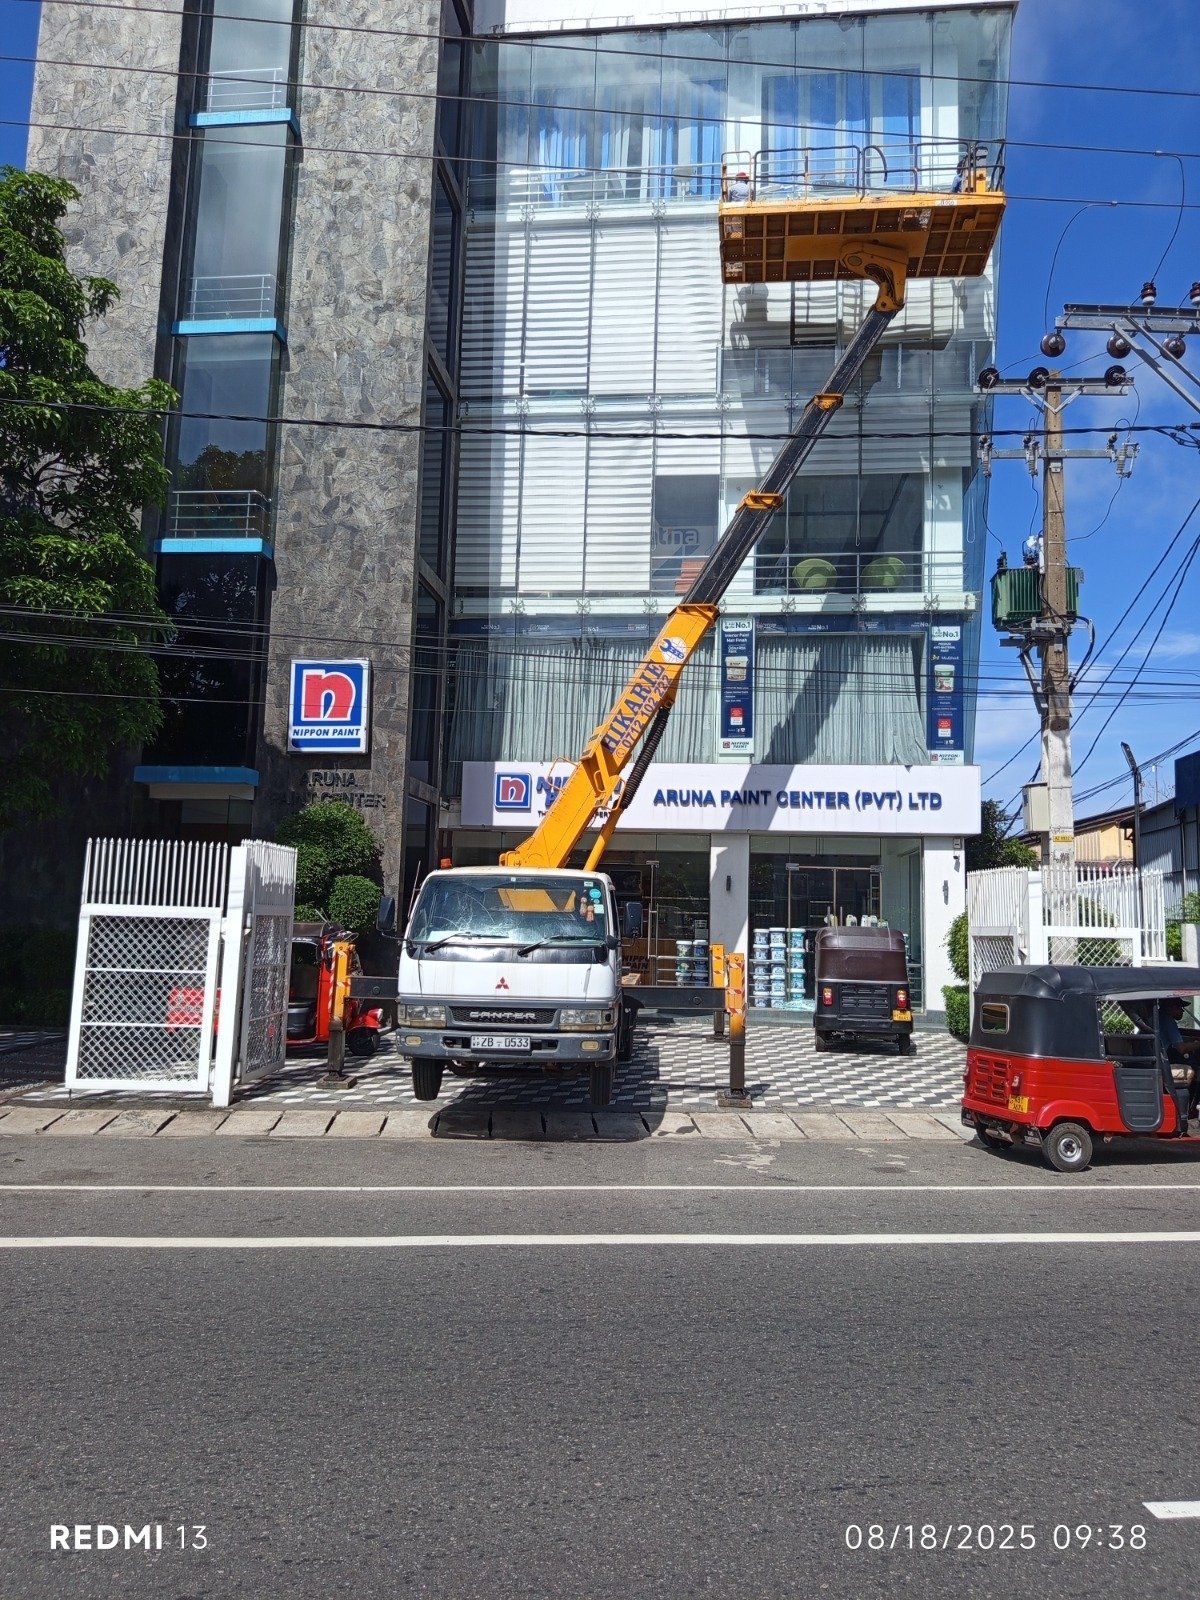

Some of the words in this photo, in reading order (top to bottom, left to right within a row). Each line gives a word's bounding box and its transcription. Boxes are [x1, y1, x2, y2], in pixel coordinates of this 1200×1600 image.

[735, 621, 751, 629] No.1
[942, 630, 959, 638] No.1
[600, 658, 666, 754] HIKARIE
[622, 719, 645, 749] 0712
[641, 696, 658, 718] 102
[292, 728, 330, 737] NIPPON
[331, 728, 361, 737] PAINT
[301, 771, 359, 788] ARUNA
[653, 789, 717, 808] ARUNA
[720, 790, 772, 808] PAINT
[776, 791, 850, 810] CENTER
[855, 790, 902, 812] (PVT)
[908, 792, 943, 811] LTD
[469, 1011, 537, 1020] CANTER
[481, 1037, 494, 1047] ZB
[504, 1037, 529, 1048] 0533
